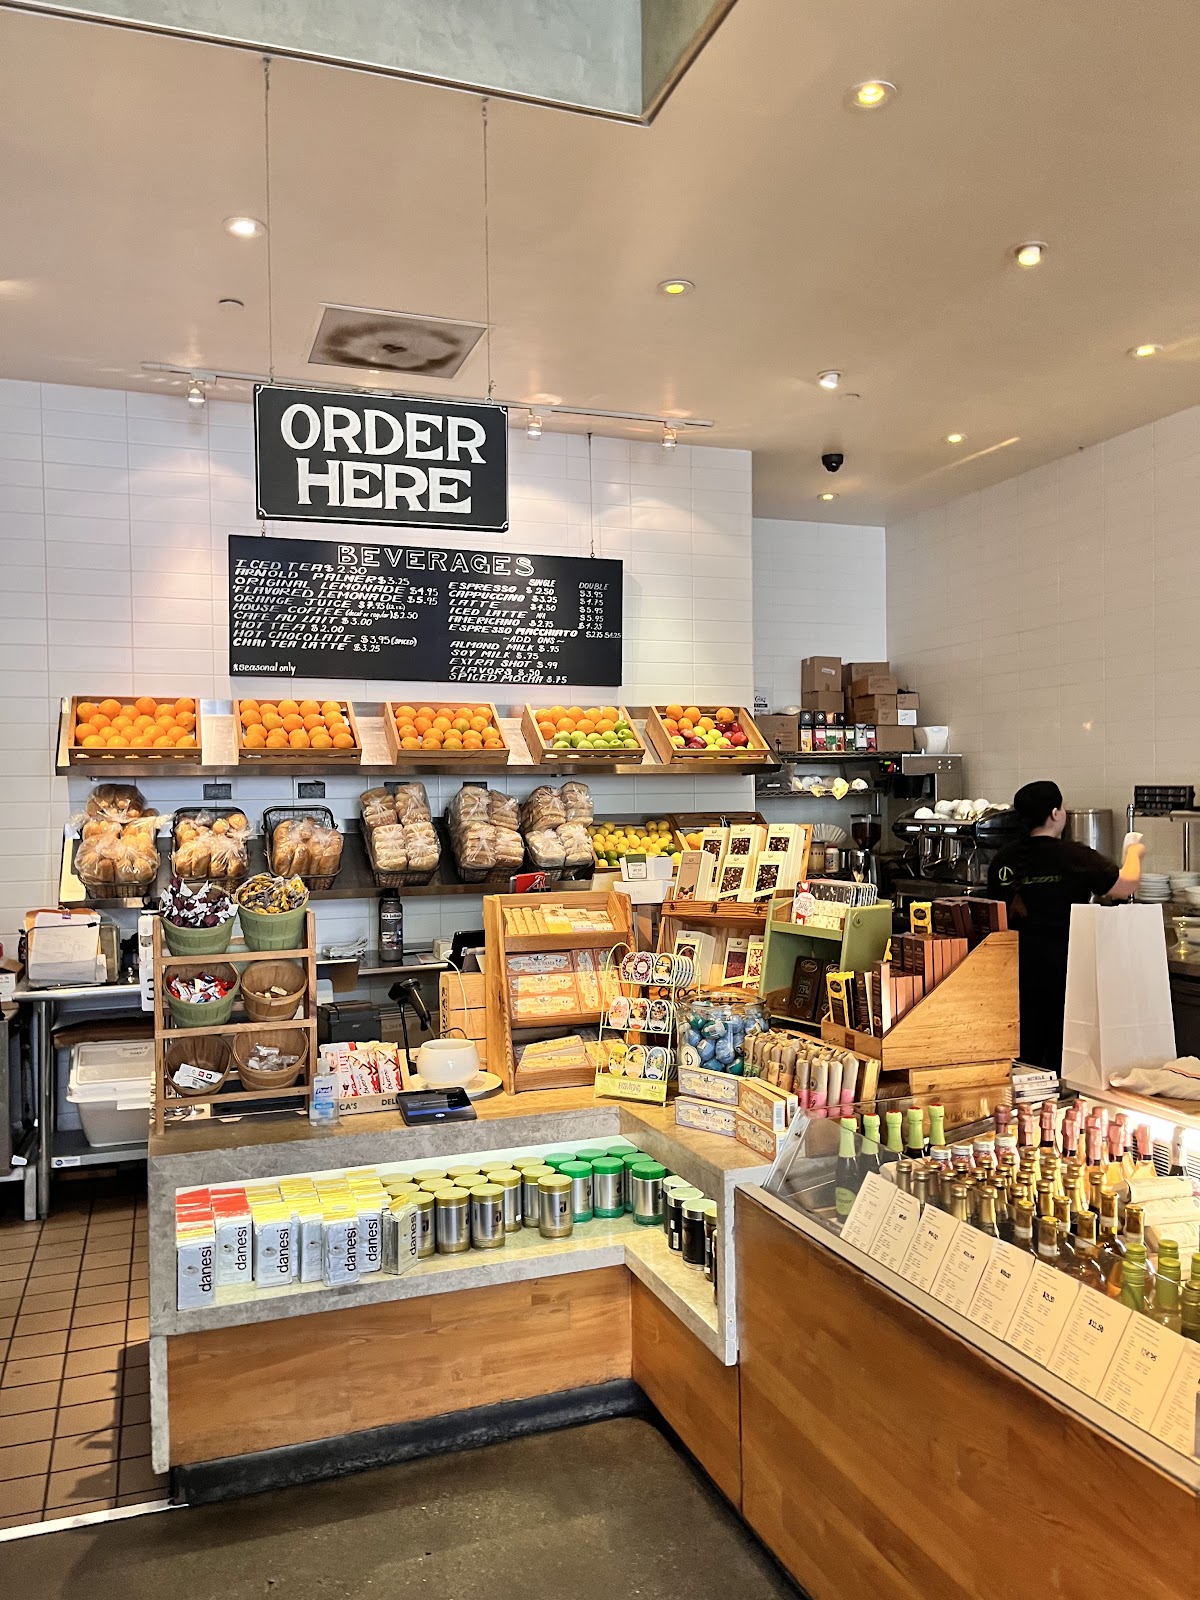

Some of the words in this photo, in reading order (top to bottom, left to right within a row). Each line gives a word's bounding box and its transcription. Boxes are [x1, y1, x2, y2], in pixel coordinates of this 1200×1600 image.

[280, 403, 486, 464] ORDER
[296, 457, 471, 513] HERE
[235, 559, 281, 570] ICED
[288, 562, 323, 572] TEA
[337, 545, 535, 577] BEVERAGES
[234, 568, 299, 579] ARNOLD
[313, 572, 377, 584] PALMER
[378, 576, 410, 585] $3.25
[234, 577, 311, 588] ORIGINAL
[320, 582, 407, 595] LEMONADE
[409, 587, 438, 596] $4.95
[448, 582, 517, 593] ESPRESSO
[579, 590, 603, 598] $3.95
[528, 579, 556, 587] SINGLE
[579, 582, 610, 590] DOUBLE
[234, 595, 295, 605] ORANGE
[304, 598, 352, 609] JUICE
[317, 590, 403, 604] LEMONADE
[407, 596, 438, 605] $5.95
[448, 590, 526, 602] CAPPUCCINO
[233, 603, 281, 613] HOUSE
[287, 605, 346, 617] COFFEE
[449, 599, 501, 609] LATTE
[579, 606, 603, 614] $5.95
[449, 607, 480, 615] ICED
[485, 609, 528, 619] LATTE
[275, 613, 298, 622] AU
[301, 616, 338, 625] LAIT
[341, 617, 372, 626] $3.00
[448, 616, 521, 626] AMERICANO
[234, 621, 264, 629] HOT
[269, 623, 305, 632] TEA
[311, 624, 344, 633] $2.00
[448, 624, 512, 635] ESPRESSO
[515, 627, 578, 638] MACCHIATO
[233, 630, 264, 638] HOT
[268, 631, 356, 643] CHOCOLATE
[360, 635, 390, 645] $3.95
[233, 638, 266, 647] CHAI
[271, 640, 297, 648] TEA
[301, 641, 347, 650] LATTE
[353, 644, 381, 653] $3.25
[450, 641, 500, 650] ALMOND
[279, 662, 296, 676] only
[449, 658, 495, 666] EXTRA
[500, 660, 532, 668] SHOT
[449, 673, 497, 682] SPICED
[500, 675, 544, 683] MOCHA
[450, 666, 513, 676] FLAVORS
[366, 1219, 378, 1262] danesi
[235, 1226, 247, 1270] danesi
[277, 1229, 289, 1273] danesi
[345, 1227, 356, 1271] danesi
[199, 1246, 212, 1292] danesi
